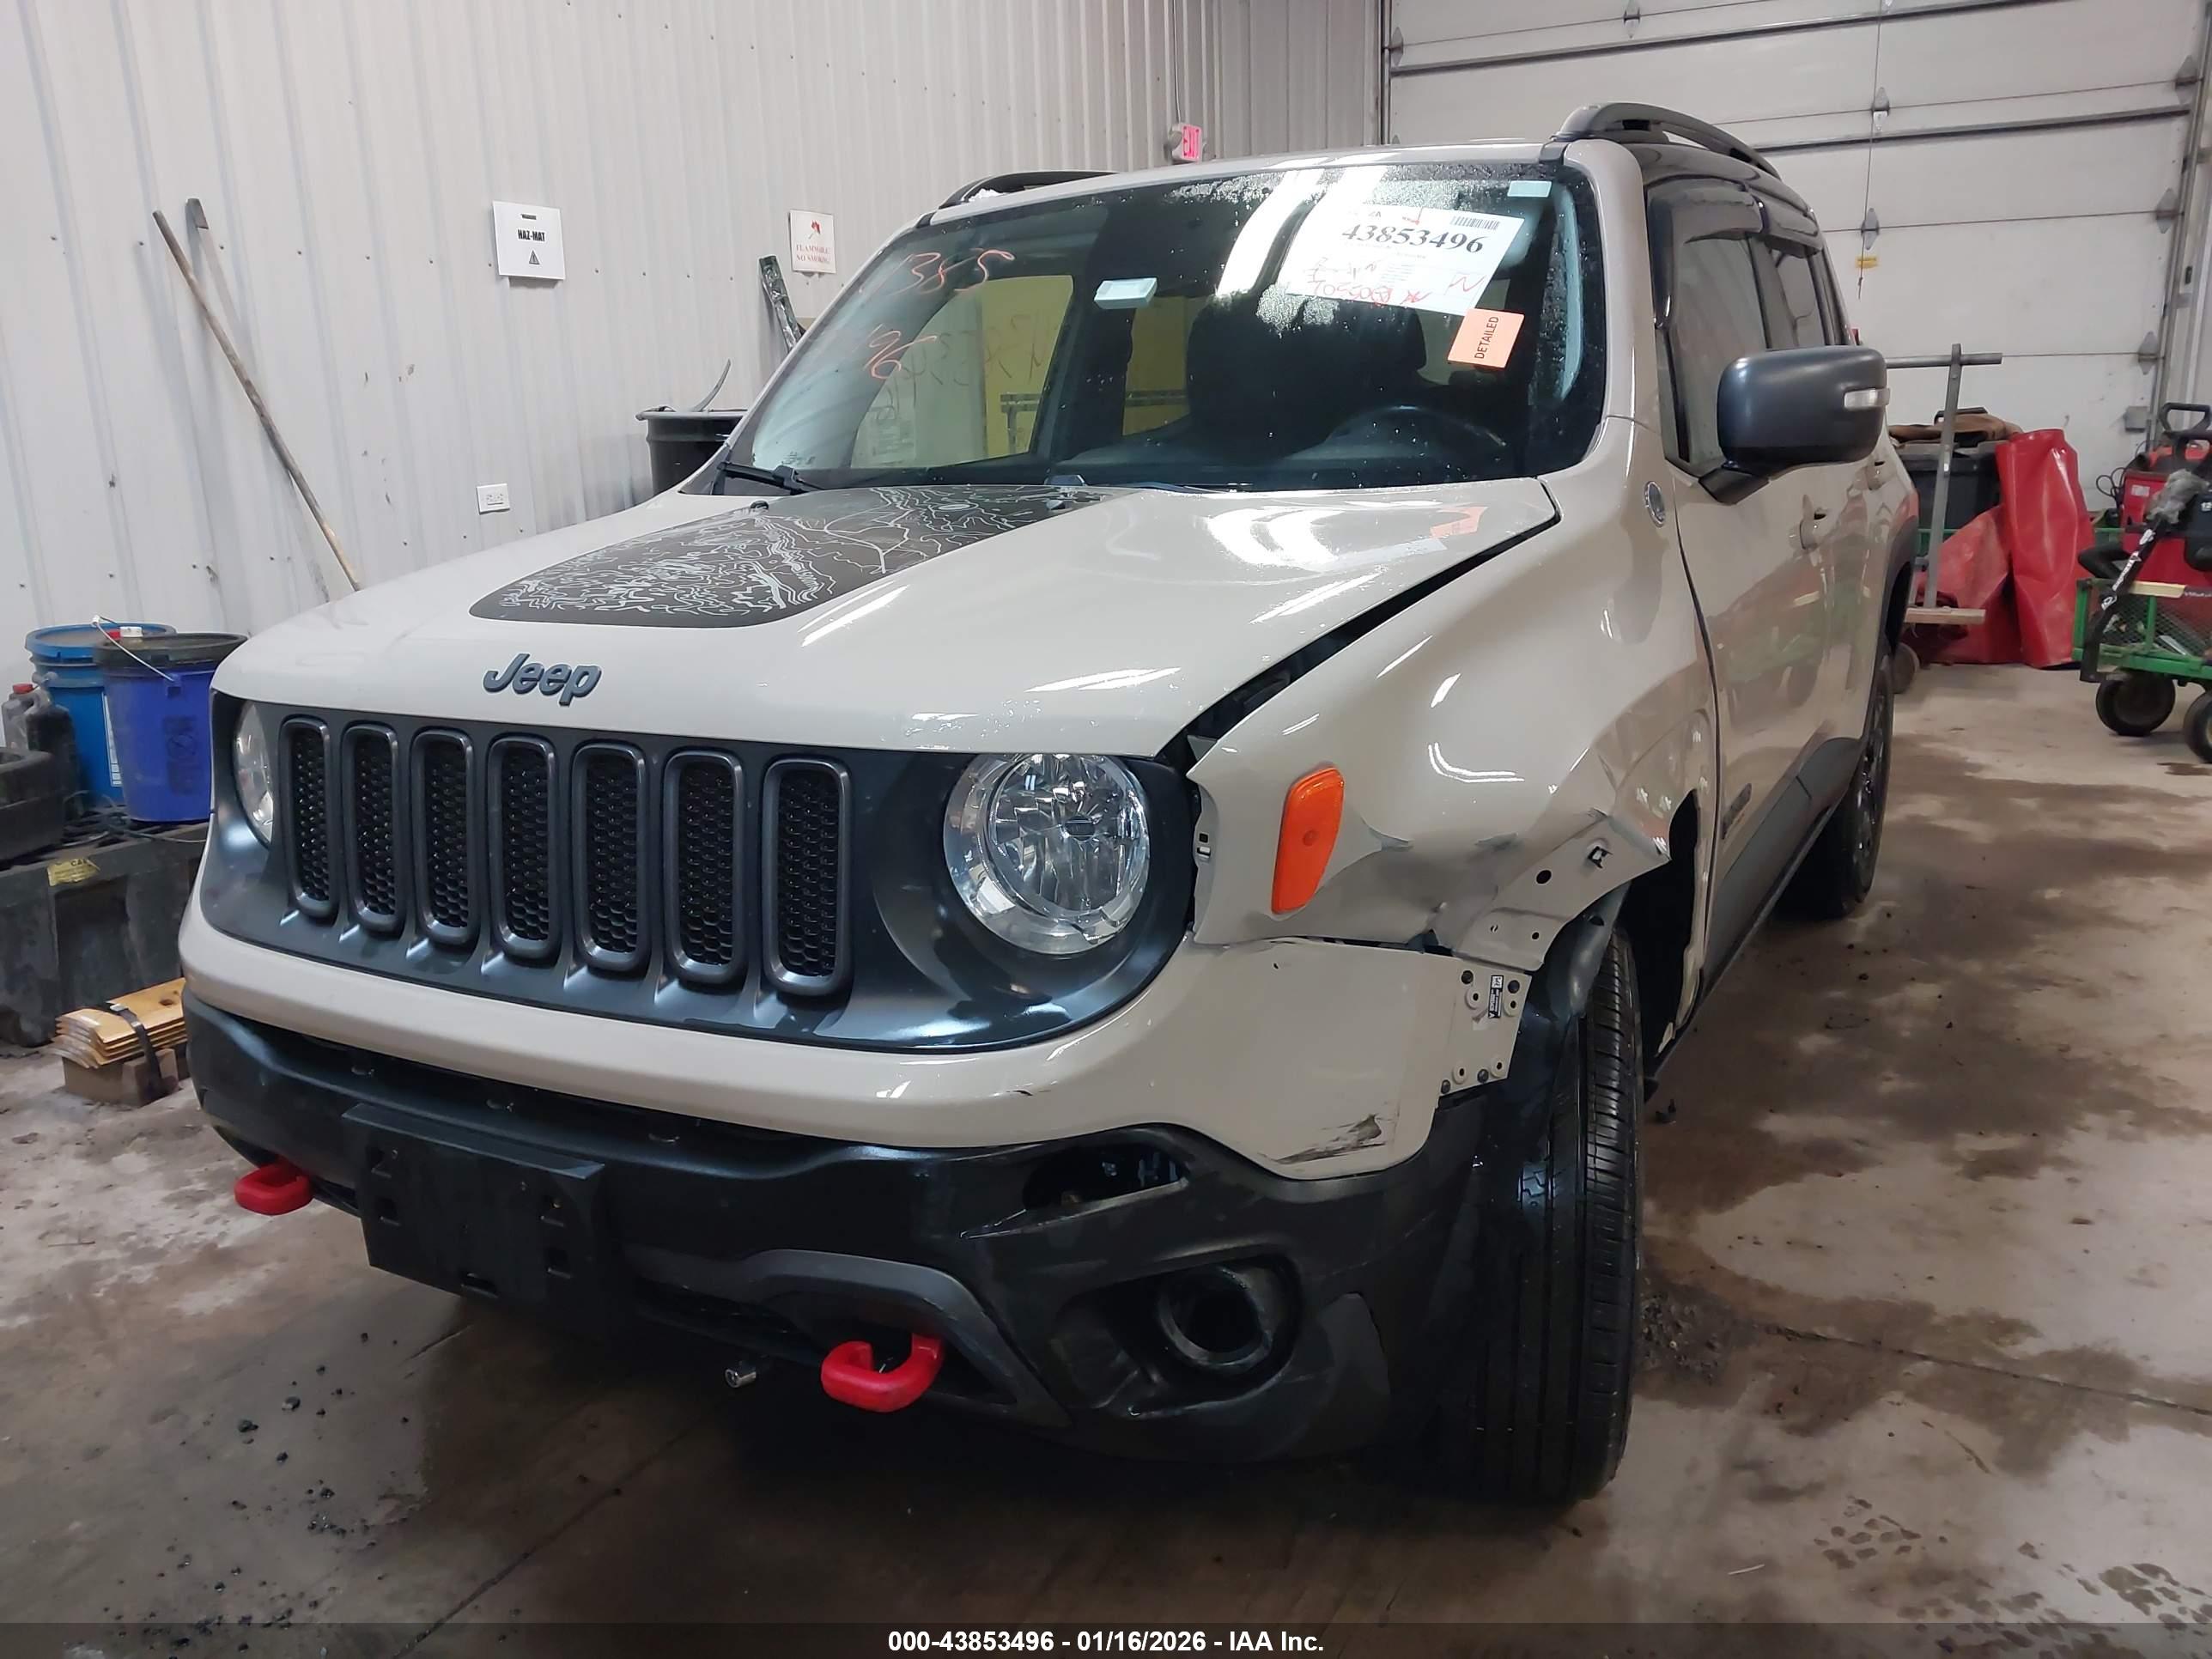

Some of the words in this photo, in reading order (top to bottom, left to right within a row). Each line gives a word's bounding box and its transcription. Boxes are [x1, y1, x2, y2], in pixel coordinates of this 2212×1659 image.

[517, 228, 546, 241] HAZ-MAT
[1341, 223, 1489, 254] 43853496
[1474, 316, 1499, 359] DETAILED
[483, 653, 602, 707] Jeep
